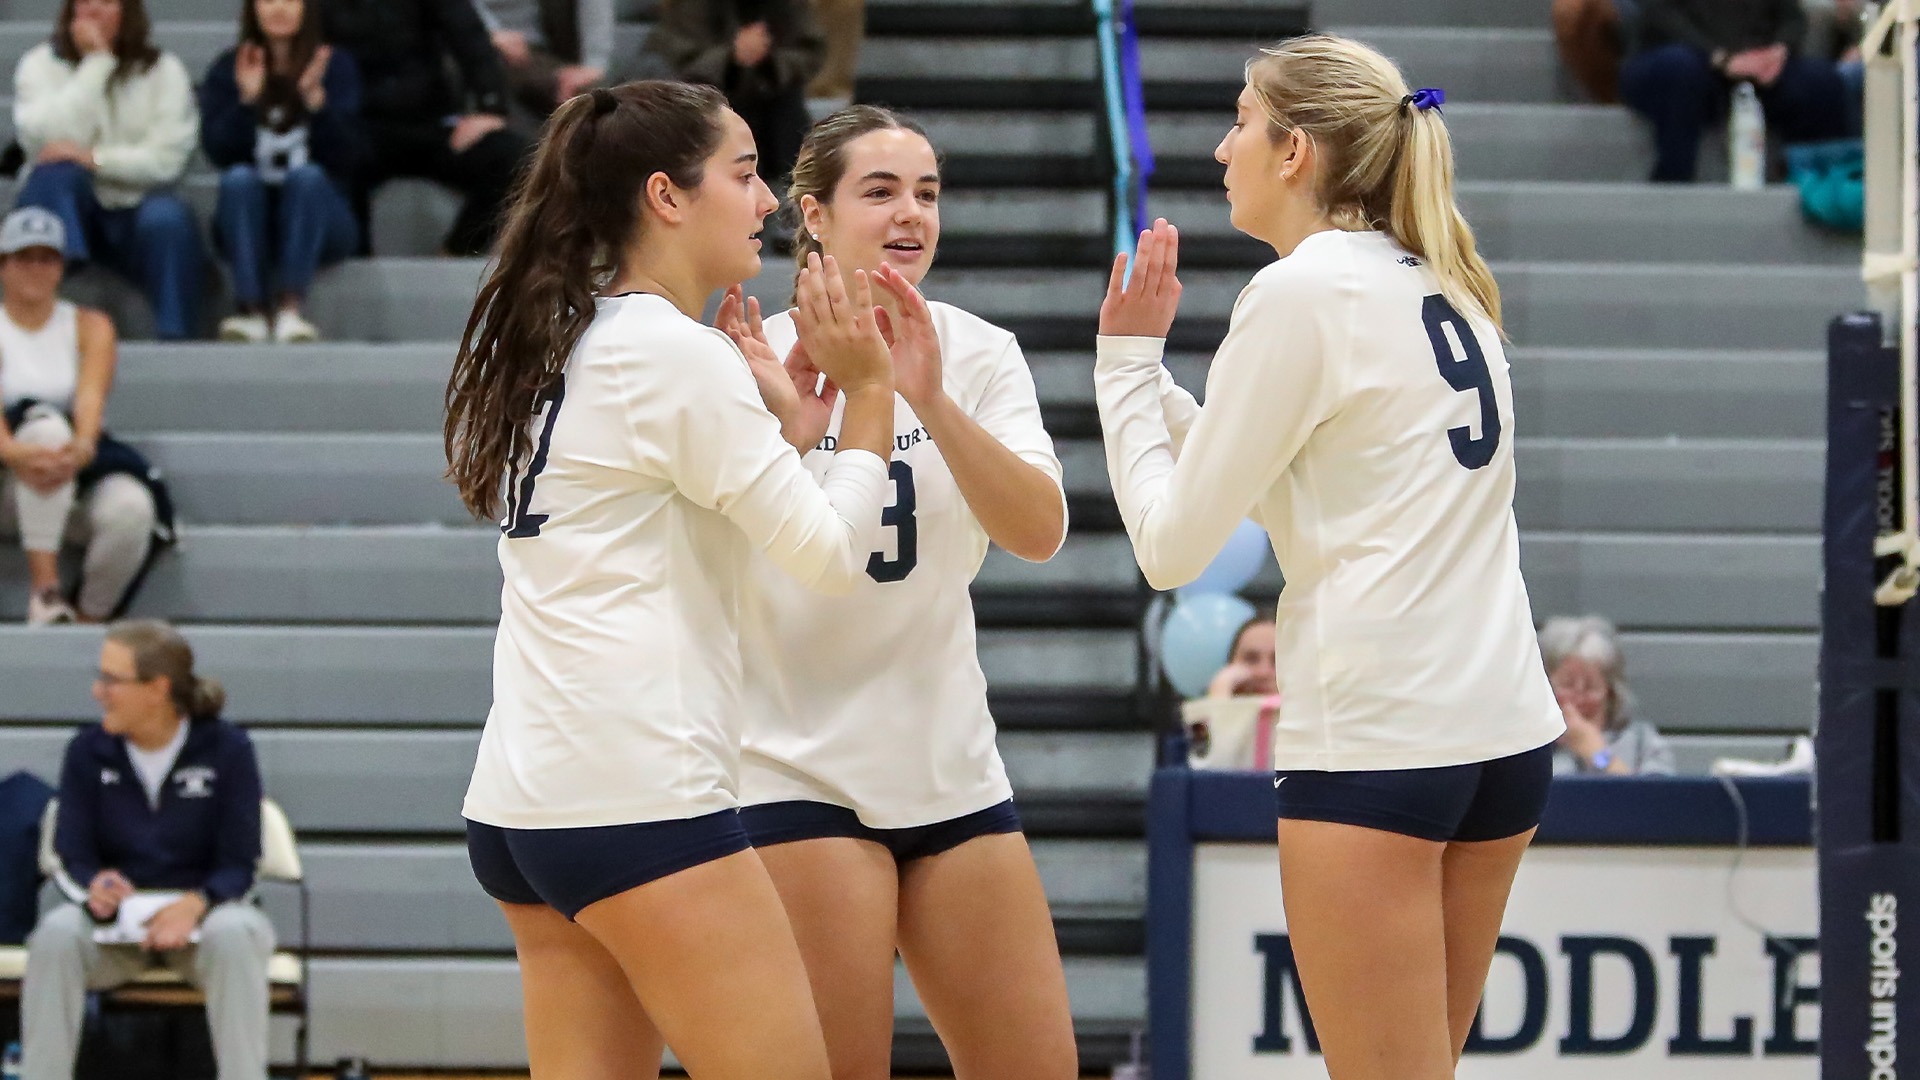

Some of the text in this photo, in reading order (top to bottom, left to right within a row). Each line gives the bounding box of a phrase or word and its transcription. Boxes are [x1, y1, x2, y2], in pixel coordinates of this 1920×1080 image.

[1422, 293, 1501, 470] 9
[865, 460, 918, 583] 3
[1253, 934, 1821, 1056] DDLE
[1864, 893, 1901, 998] sports
